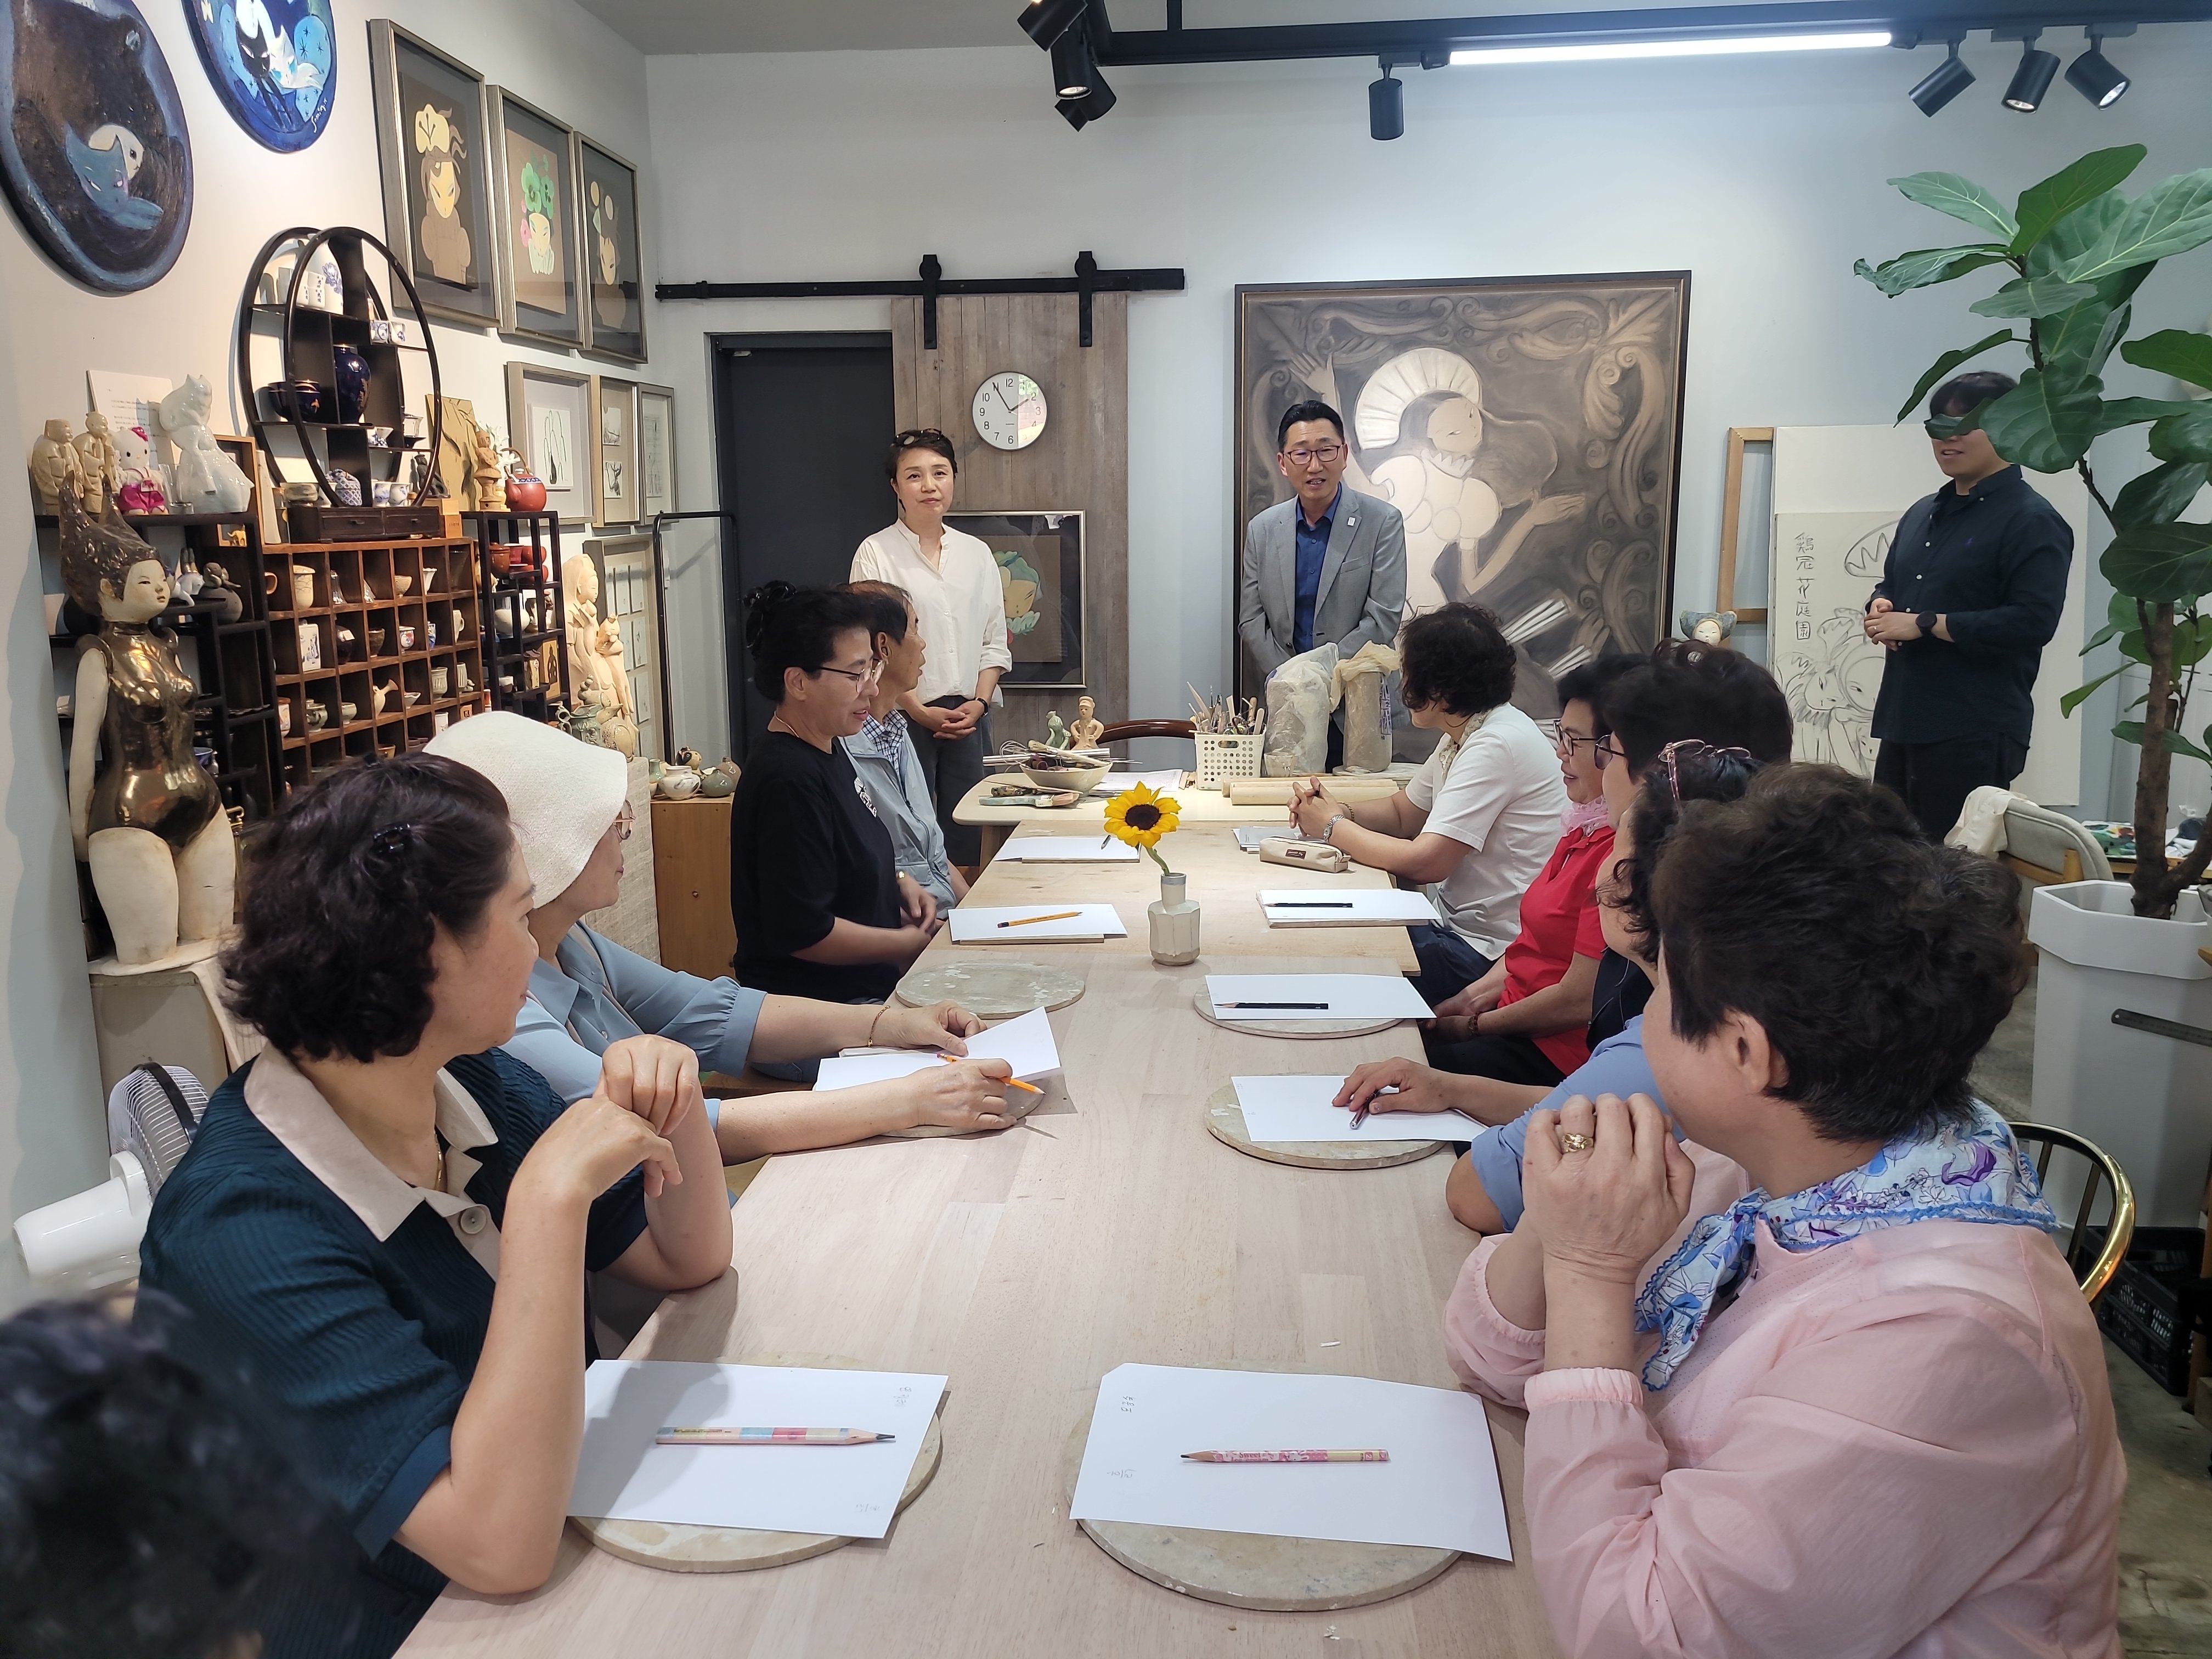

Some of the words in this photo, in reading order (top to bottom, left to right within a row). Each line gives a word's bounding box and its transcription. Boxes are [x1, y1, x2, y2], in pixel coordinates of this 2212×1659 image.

[1006, 379, 1013, 387] 12
[982, 392, 990, 402] 10
[1031, 392, 1036, 401] 2
[979, 408, 985, 416] 9
[1035, 406, 1041, 415] 3
[984, 421, 990, 430] 8
[994, 432, 1000, 441] 7
[1008, 435, 1014, 444] 6
